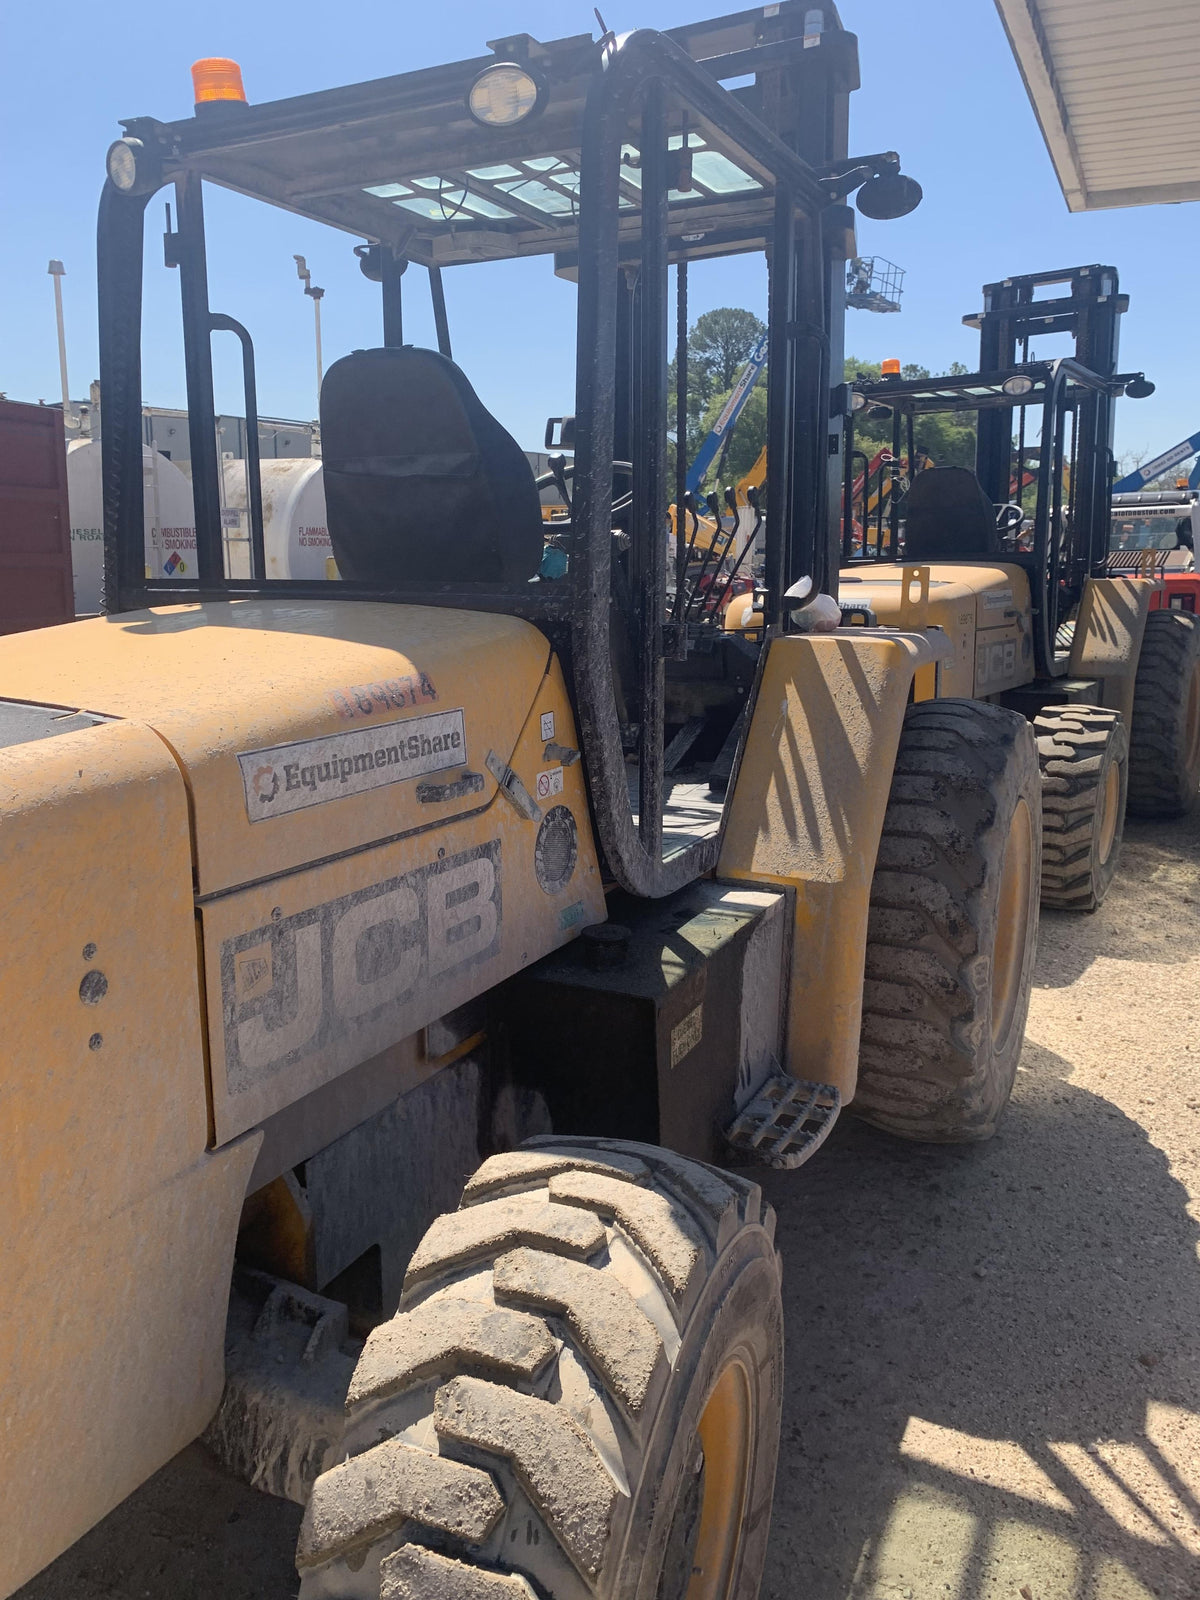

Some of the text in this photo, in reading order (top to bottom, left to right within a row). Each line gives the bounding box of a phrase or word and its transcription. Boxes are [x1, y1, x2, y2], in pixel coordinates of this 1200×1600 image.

[151, 527, 197, 538] CMBUSTIBLE
[299, 527, 330, 536] FLAMMABL
[284, 728, 462, 793] EquipmentShare
[237, 856, 498, 1068] JCB
